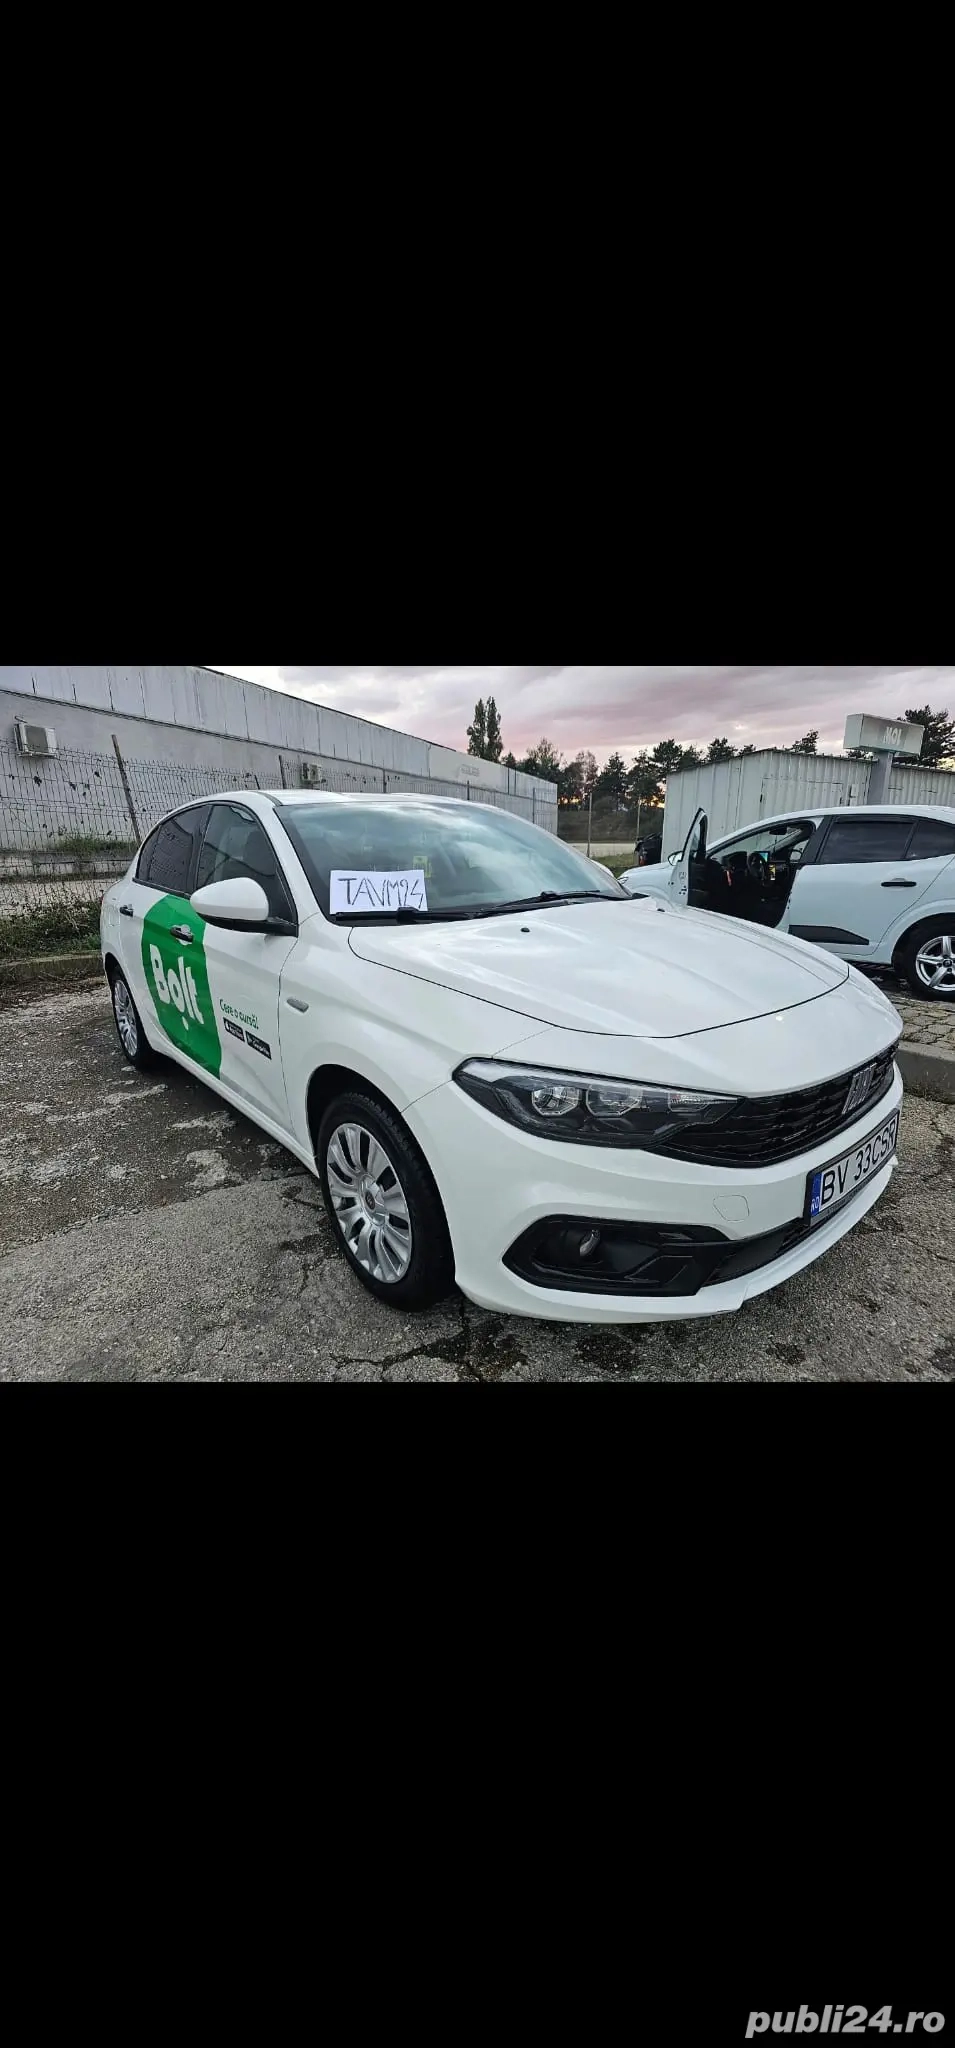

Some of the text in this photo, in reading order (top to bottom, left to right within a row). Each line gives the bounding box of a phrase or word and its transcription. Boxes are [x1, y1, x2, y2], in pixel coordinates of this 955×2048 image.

[337, 877, 424, 909] TAVM24
[150, 944, 204, 1030] Bolt
[219, 998, 234, 1017] Cere
[821, 1159, 849, 1205] BV
[854, 1120, 896, 1181] 33CSR
[811, 1196, 819, 1213] RO
